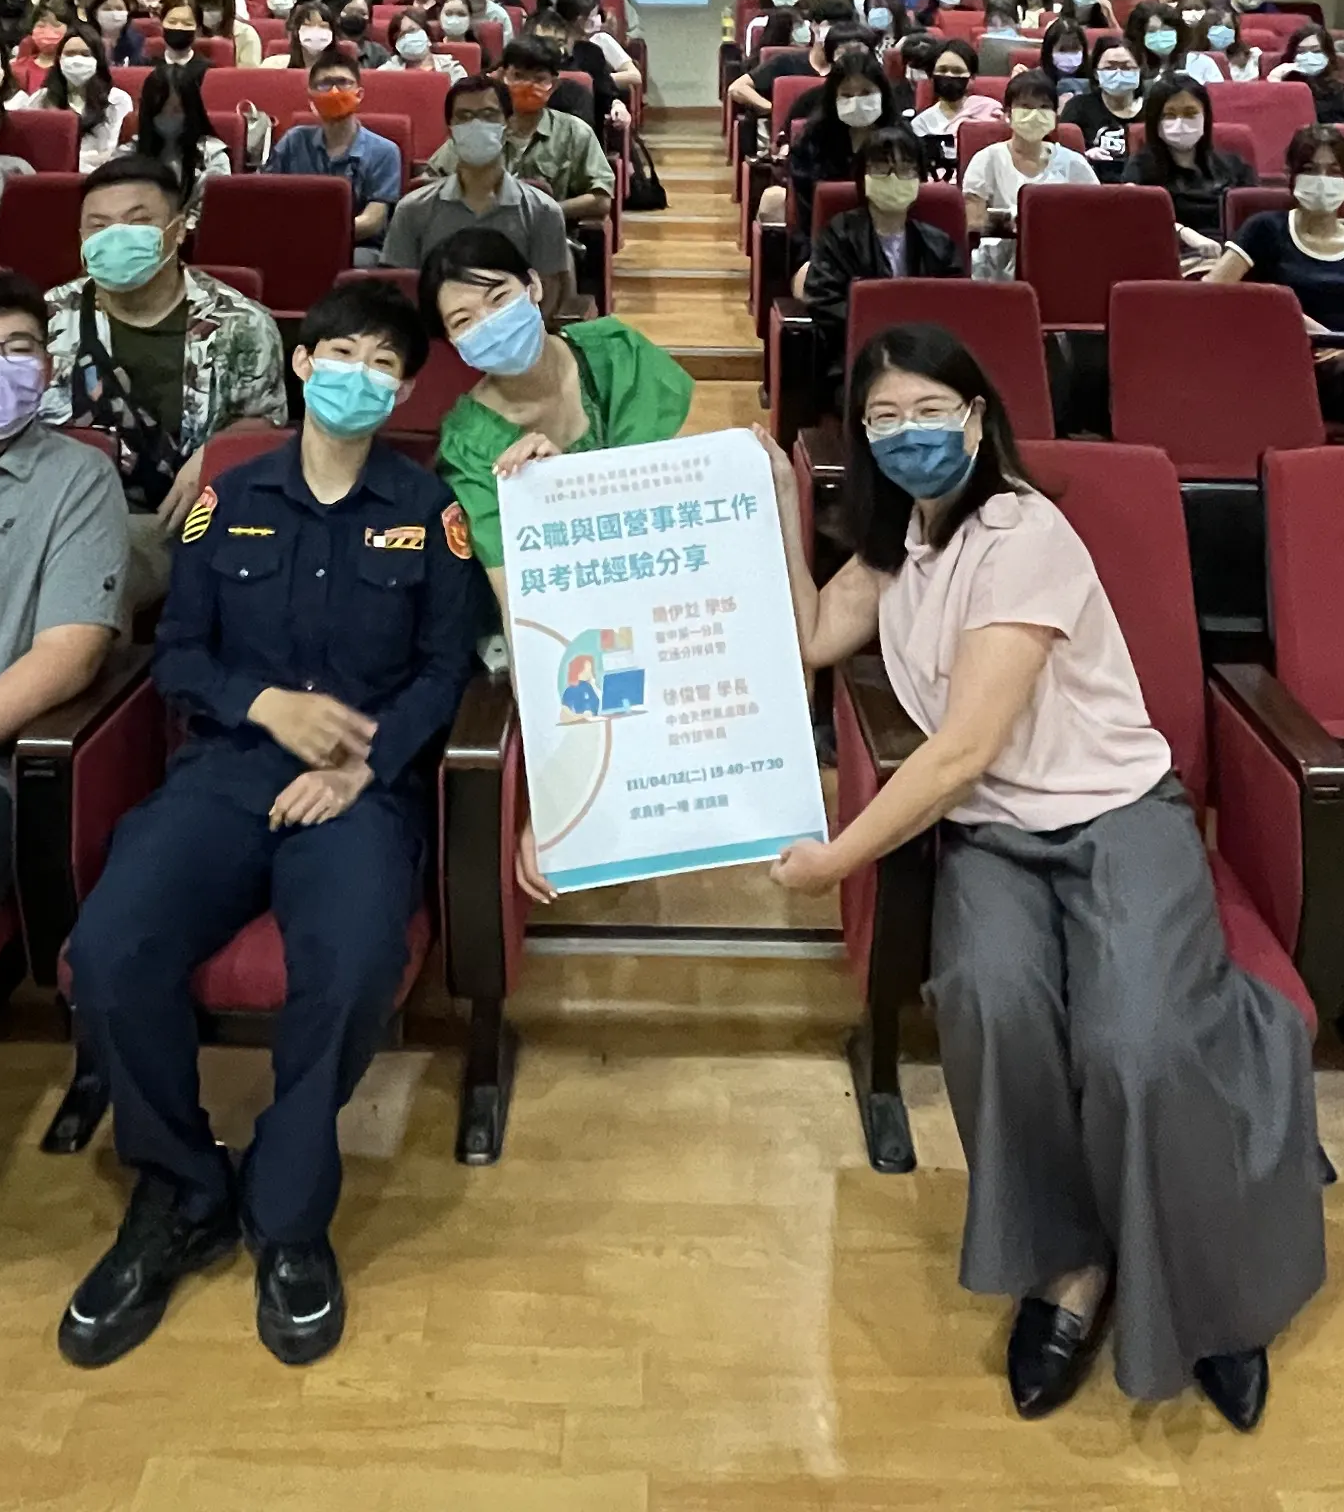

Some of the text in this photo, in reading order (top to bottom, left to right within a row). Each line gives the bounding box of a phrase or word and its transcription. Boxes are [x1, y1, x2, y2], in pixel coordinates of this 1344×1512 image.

[516, 493, 758, 552] 公職與國營事業工作
[520, 544, 709, 596] 與考試經驗分享
